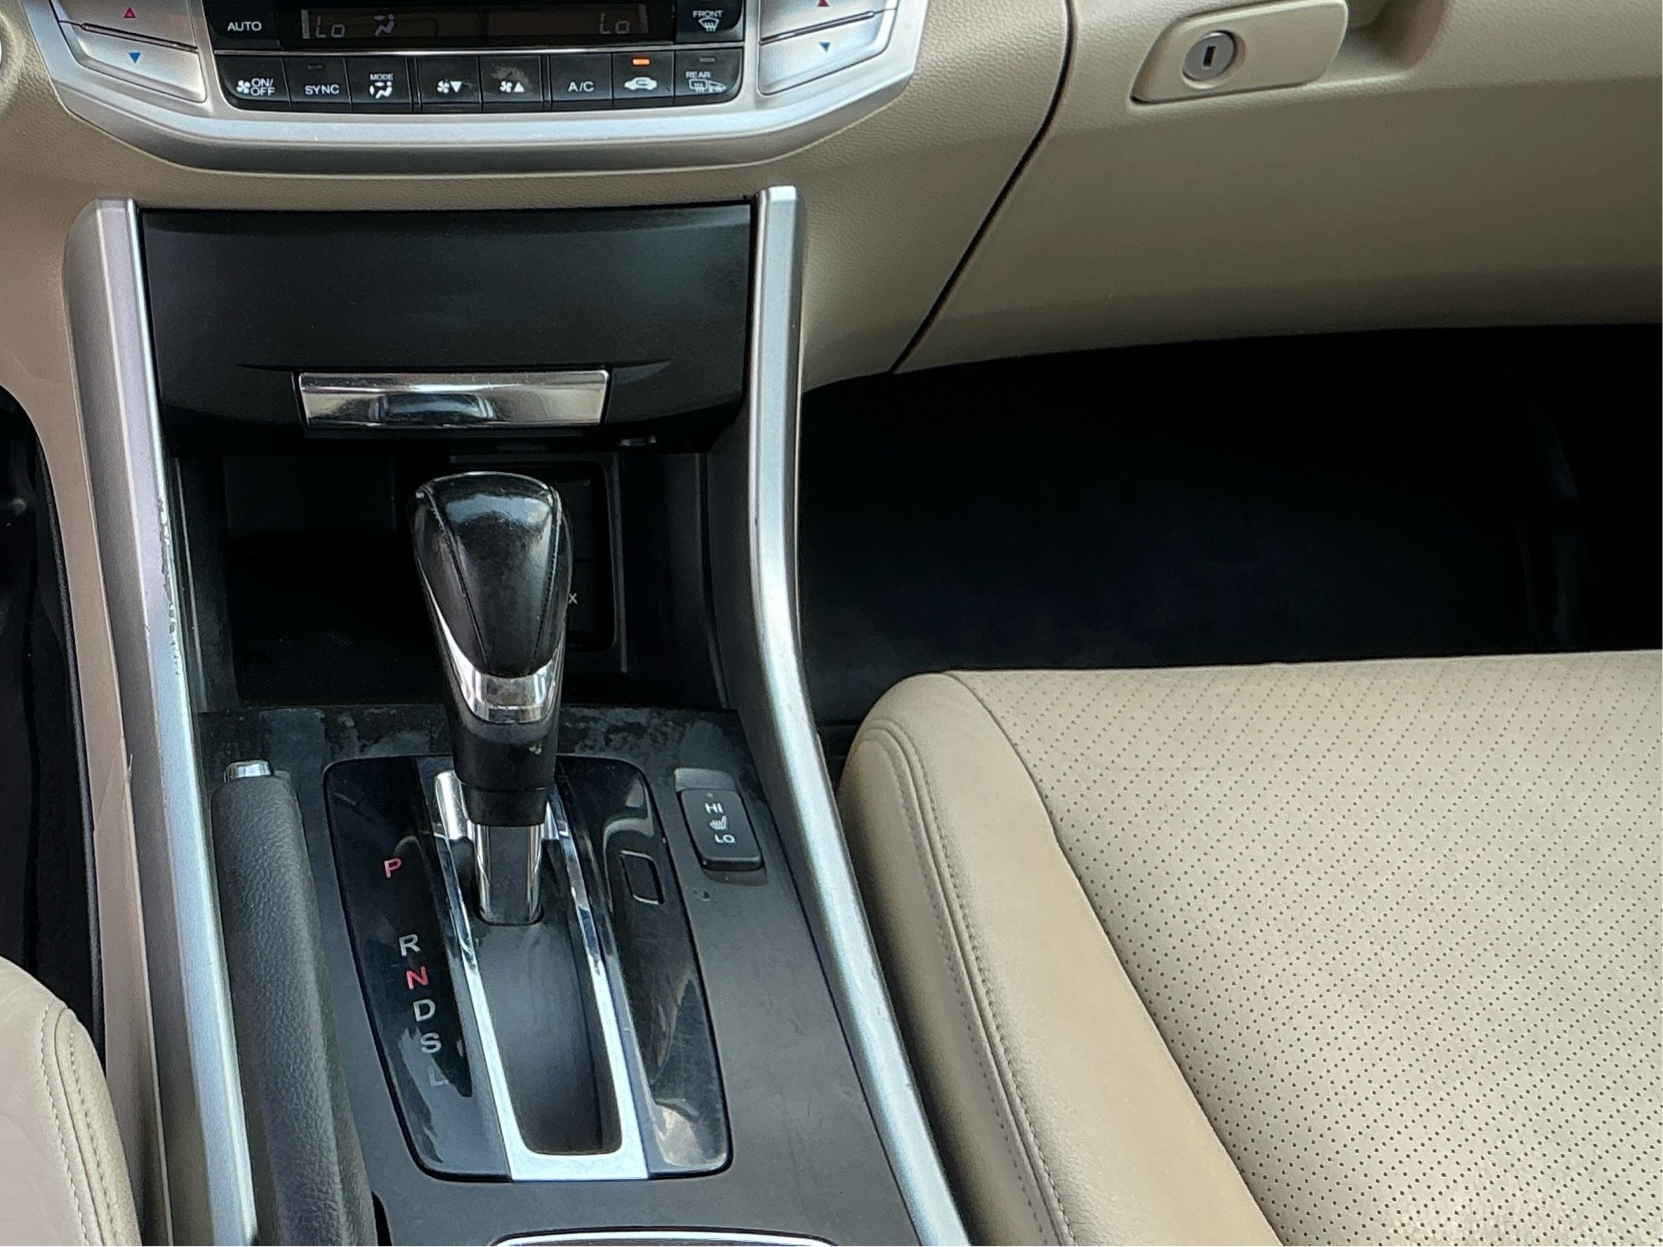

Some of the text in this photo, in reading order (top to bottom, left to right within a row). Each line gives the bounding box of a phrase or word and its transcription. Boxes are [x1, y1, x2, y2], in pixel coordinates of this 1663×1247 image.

[692, 10, 724, 18] FRONT
[227, 21, 262, 32] AUTO
[369, 73, 394, 81] MODE
[686, 71, 711, 79] REAR
[251, 77, 274, 88] ON/
[568, 81, 594, 92] A/C
[250, 86, 276, 97] OFF
[304, 84, 340, 95] SYNC
[705, 802, 724, 814] HI
[714, 834, 736, 843] LO
[383, 857, 402, 879] P
[399, 933, 421, 957] R
[405, 966, 429, 990] N
[413, 998, 436, 1022] D
[420, 1032, 442, 1054] S
[427, 1065, 449, 1087] L
